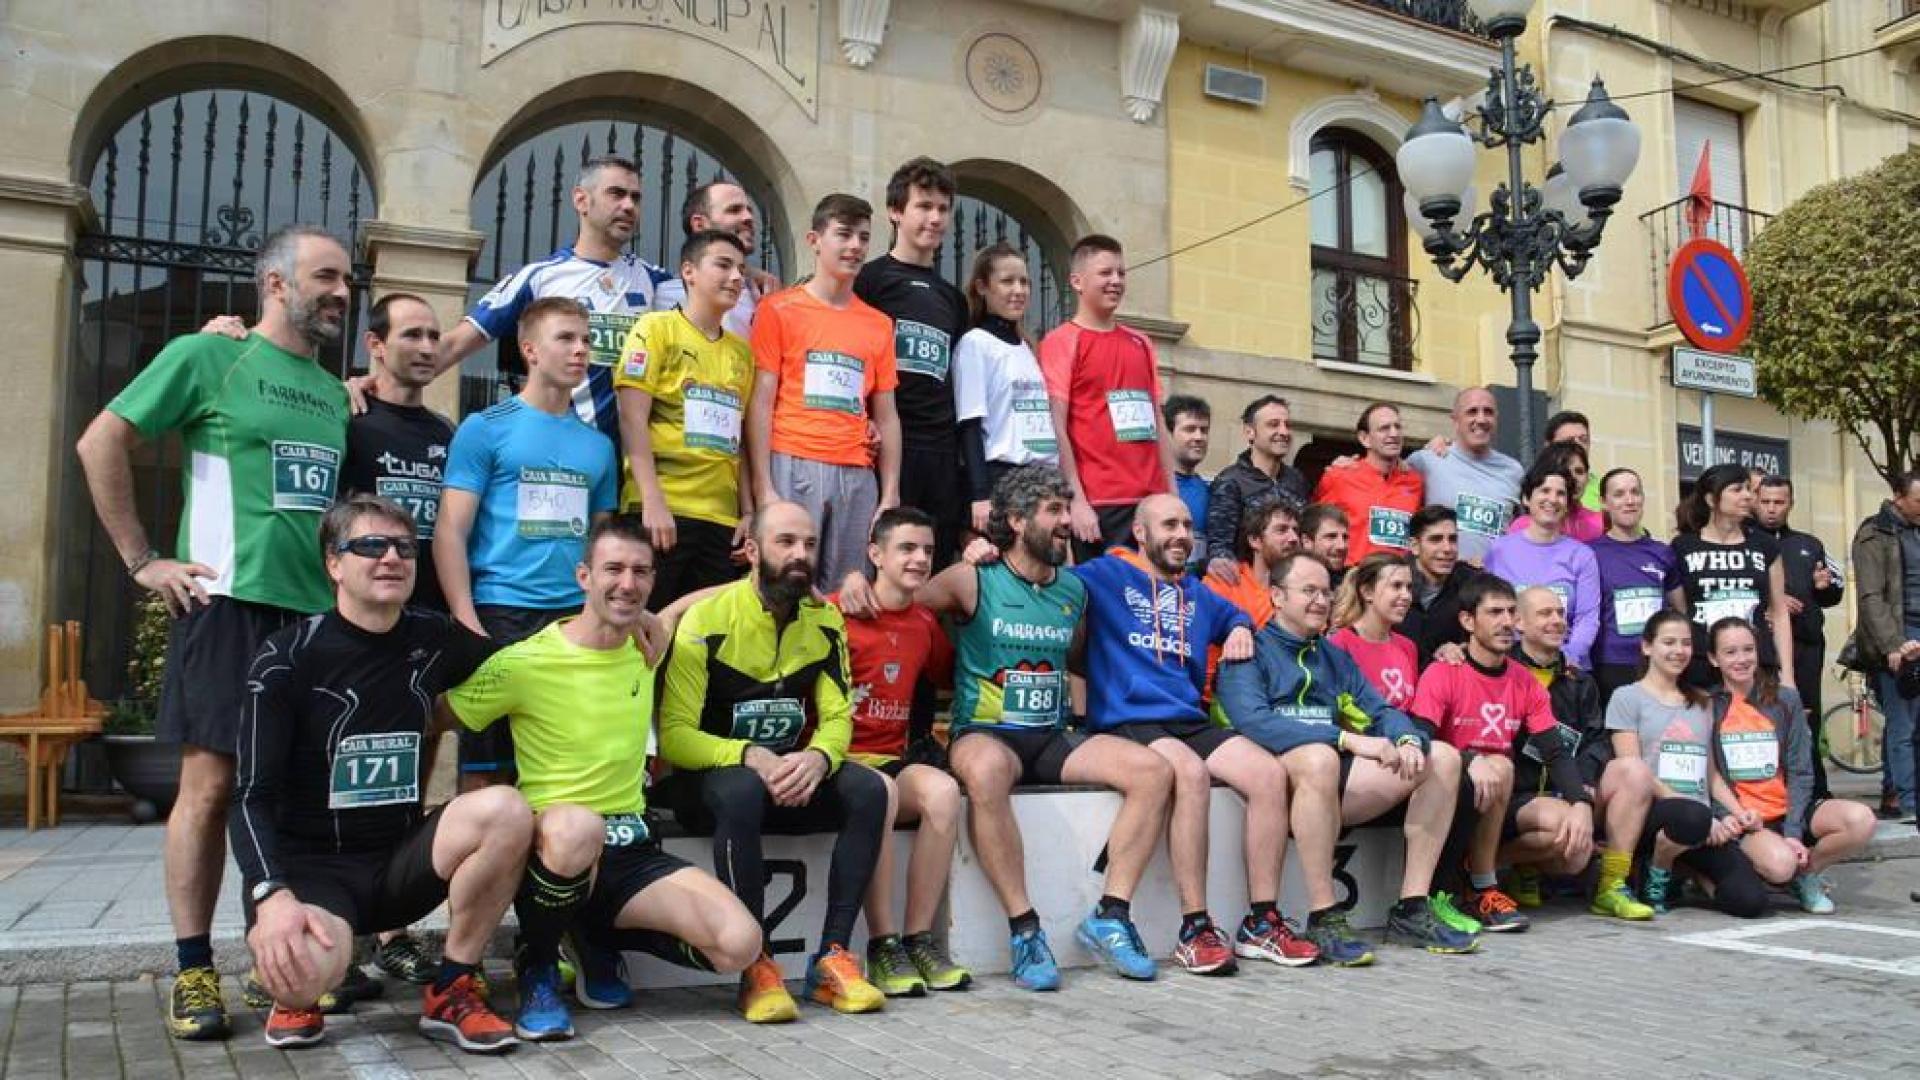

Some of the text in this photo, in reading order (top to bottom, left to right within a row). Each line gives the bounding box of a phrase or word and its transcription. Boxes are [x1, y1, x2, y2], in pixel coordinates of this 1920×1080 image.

[905, 337, 940, 361] 189
[289, 464, 329, 491] 167
[393, 497, 437, 521] 78
[1464, 506, 1494, 524] 160
[1379, 520, 1405, 535] 193
[1685, 549, 1766, 572] WHO'S
[1128, 632, 1191, 656] adidas
[1016, 689, 1053, 710] 188
[747, 717, 791, 738] 152
[347, 756, 399, 785] 171
[758, 859, 807, 953] 2
